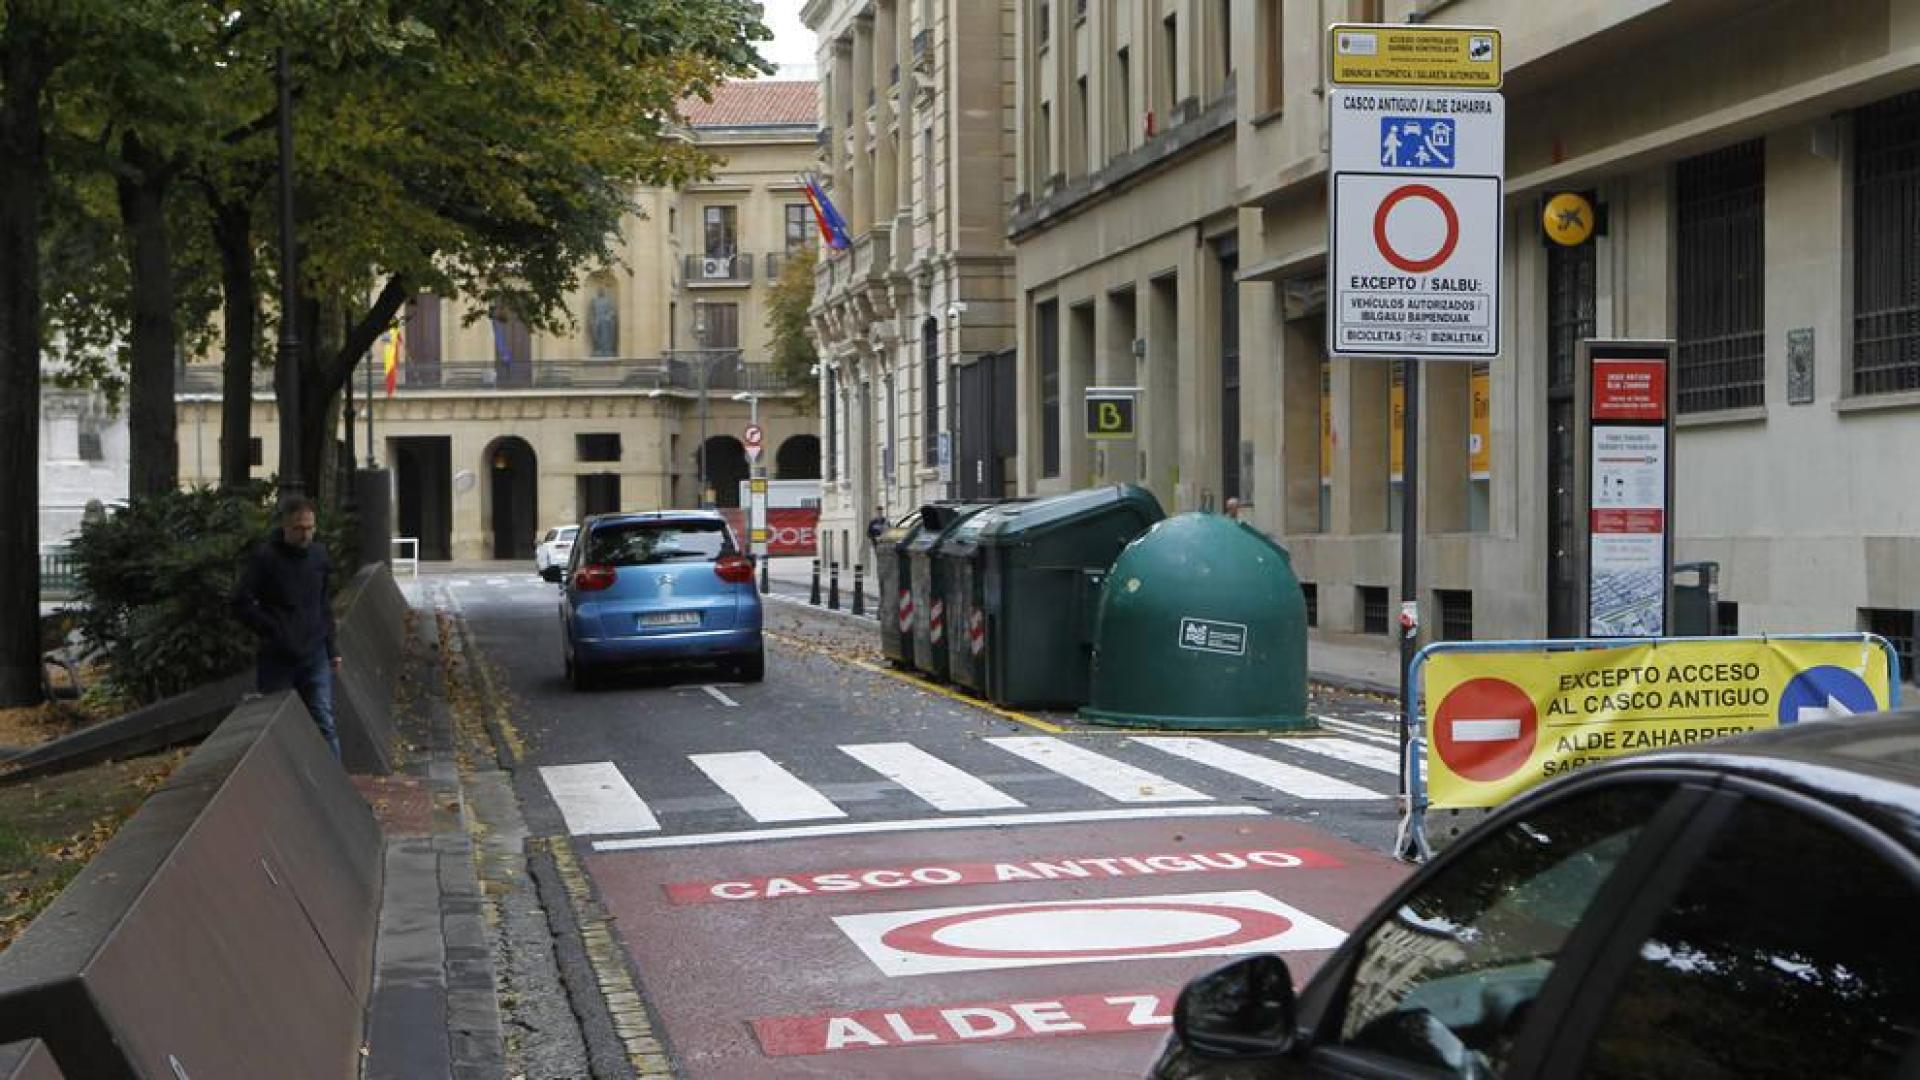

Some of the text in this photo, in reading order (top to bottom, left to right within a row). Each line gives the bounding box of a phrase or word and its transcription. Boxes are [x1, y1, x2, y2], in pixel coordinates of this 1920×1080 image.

[1342, 68, 1371, 78] DENUNCIA
[1344, 96, 1375, 111] CASCO
[1378, 98, 1417, 112] ANTIGUO
[1425, 99, 1448, 113] ALDE
[1451, 99, 1492, 114] ZAHARRA
[1351, 276, 1417, 290] EXCEPTO
[1431, 278, 1482, 292] SALBU:
[1407, 299, 1475, 311] AUTORIZADOS
[1407, 312, 1471, 323] BAIMENDUAK
[1347, 330, 1484, 343] BICICLETAS BIZIKLETAK
[1099, 403, 1121, 429] B
[1559, 662, 1760, 691] EXCEPTO ACCESO
[1546, 686, 1770, 717] AL CASCO ANTIGUO
[1556, 732, 1616, 753] ALDE
[708, 850, 1304, 901] CASCO ANTIGUO
[824, 1001, 1087, 1051] ALDE
